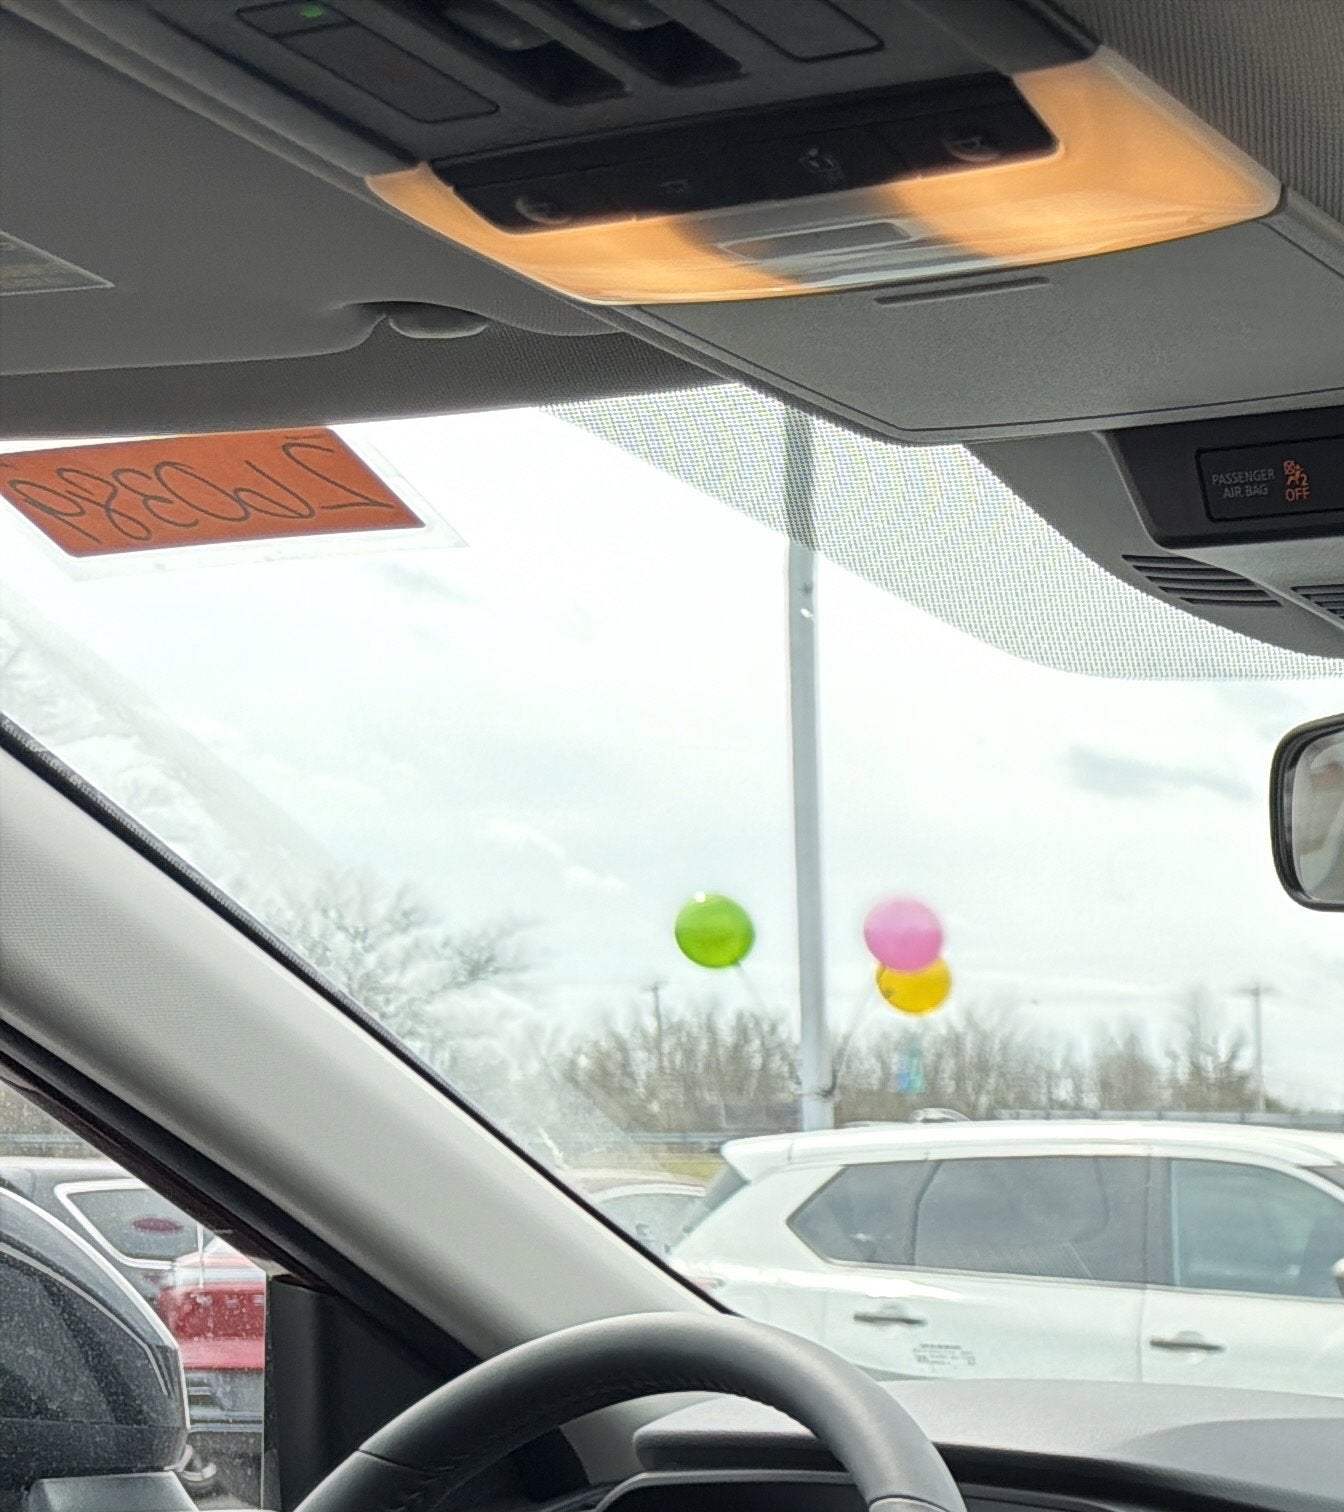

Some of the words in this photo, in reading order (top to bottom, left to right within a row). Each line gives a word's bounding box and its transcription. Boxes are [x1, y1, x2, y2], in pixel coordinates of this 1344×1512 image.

[1212, 468, 1275, 485] PASSENGER
[1224, 486, 1241, 498] AIR
[1246, 484, 1268, 497] BAG
[1286, 487, 1310, 501] OFF
